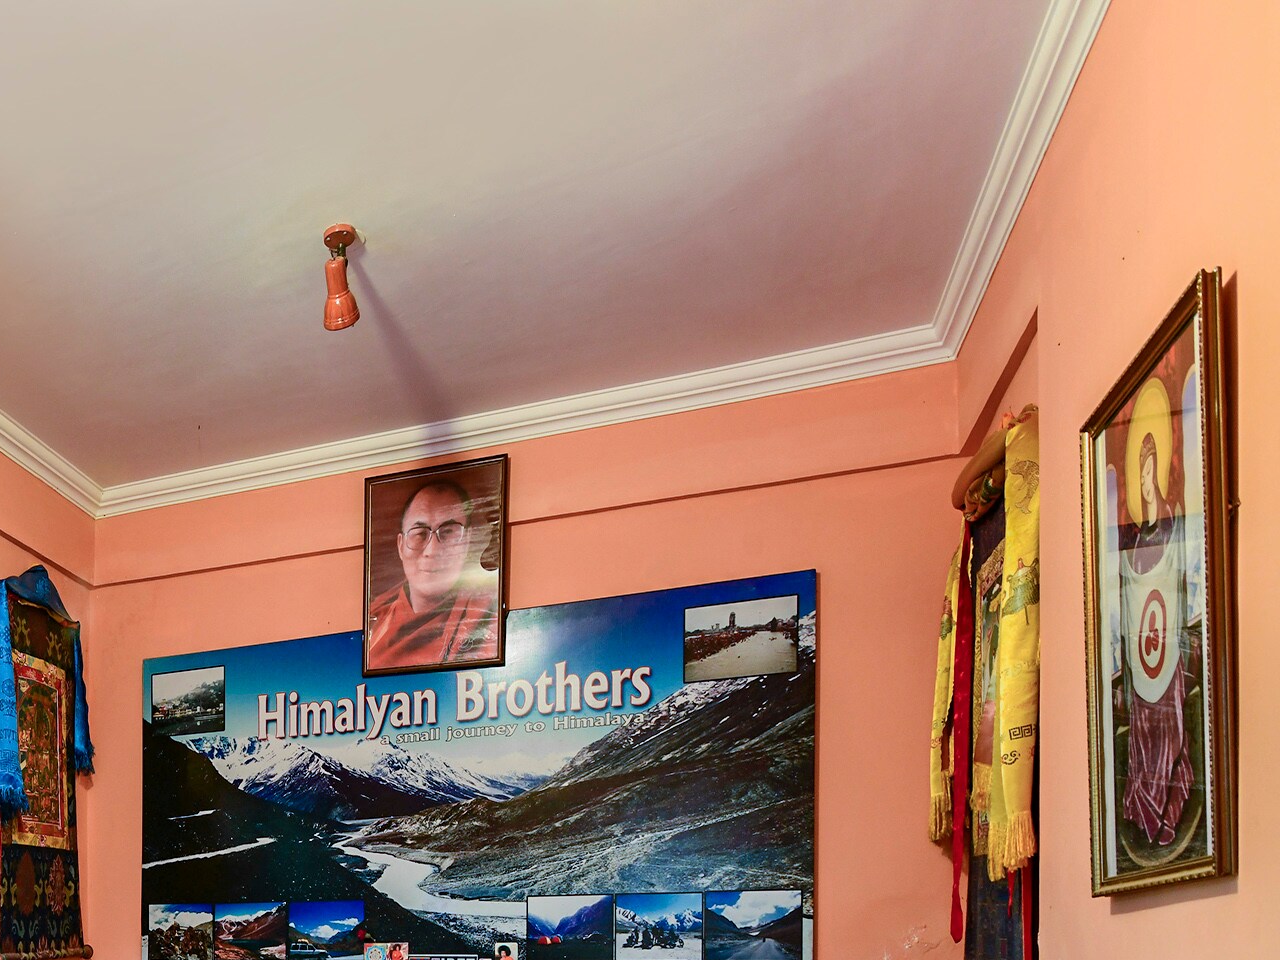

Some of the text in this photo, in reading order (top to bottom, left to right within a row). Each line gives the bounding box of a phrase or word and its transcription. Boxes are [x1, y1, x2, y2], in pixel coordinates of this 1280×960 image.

[257, 660, 652, 741] Himalyan Brothers
[380, 712, 644, 745] a small journey to Himalaya
